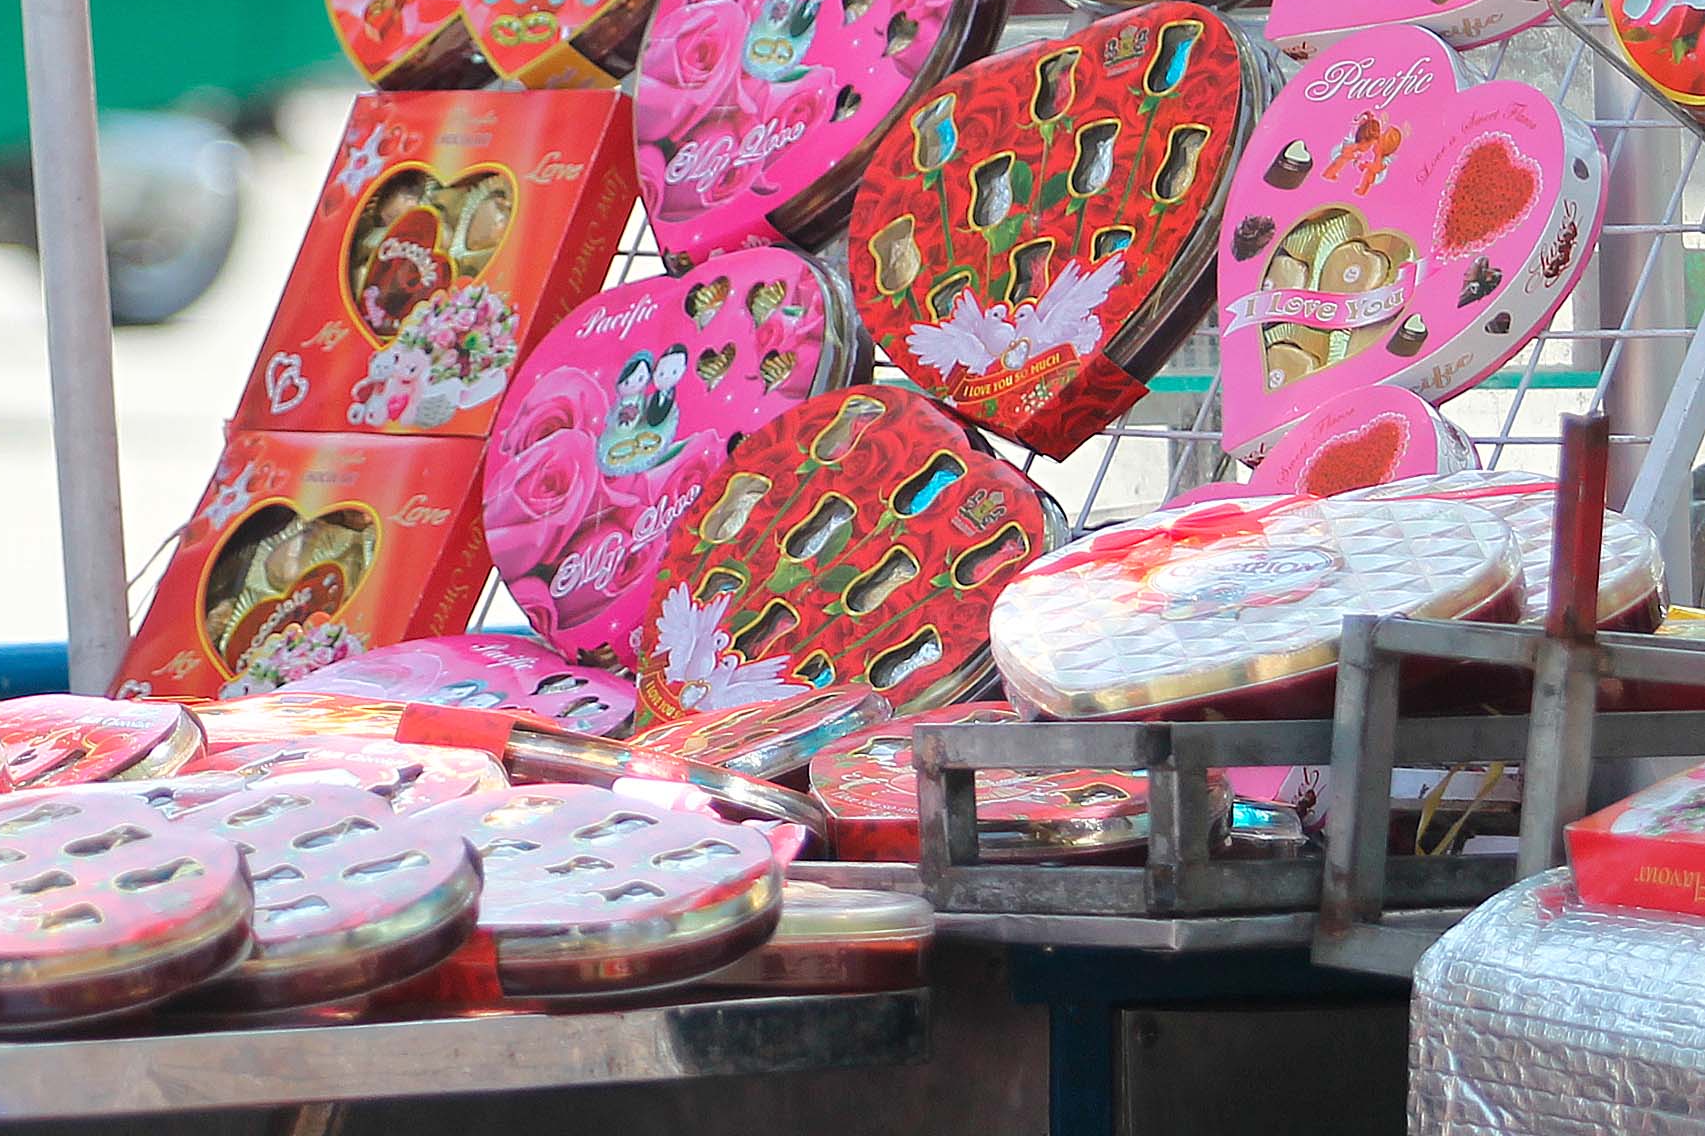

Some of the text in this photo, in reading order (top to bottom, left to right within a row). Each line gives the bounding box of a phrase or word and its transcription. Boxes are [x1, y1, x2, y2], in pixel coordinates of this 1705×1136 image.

[1305, 57, 1434, 110] Pacific
[524, 150, 586, 184] Love
[575, 294, 659, 341] Pacific
[1268, 292, 1337, 321] Love
[1345, 285, 1405, 319] You
[969, 383, 992, 398] LOVE
[993, 375, 1013, 392] YOU
[1030, 352, 1061, 375] MUCH
[390, 494, 453, 527] Love
[551, 484, 702, 599] My Love
